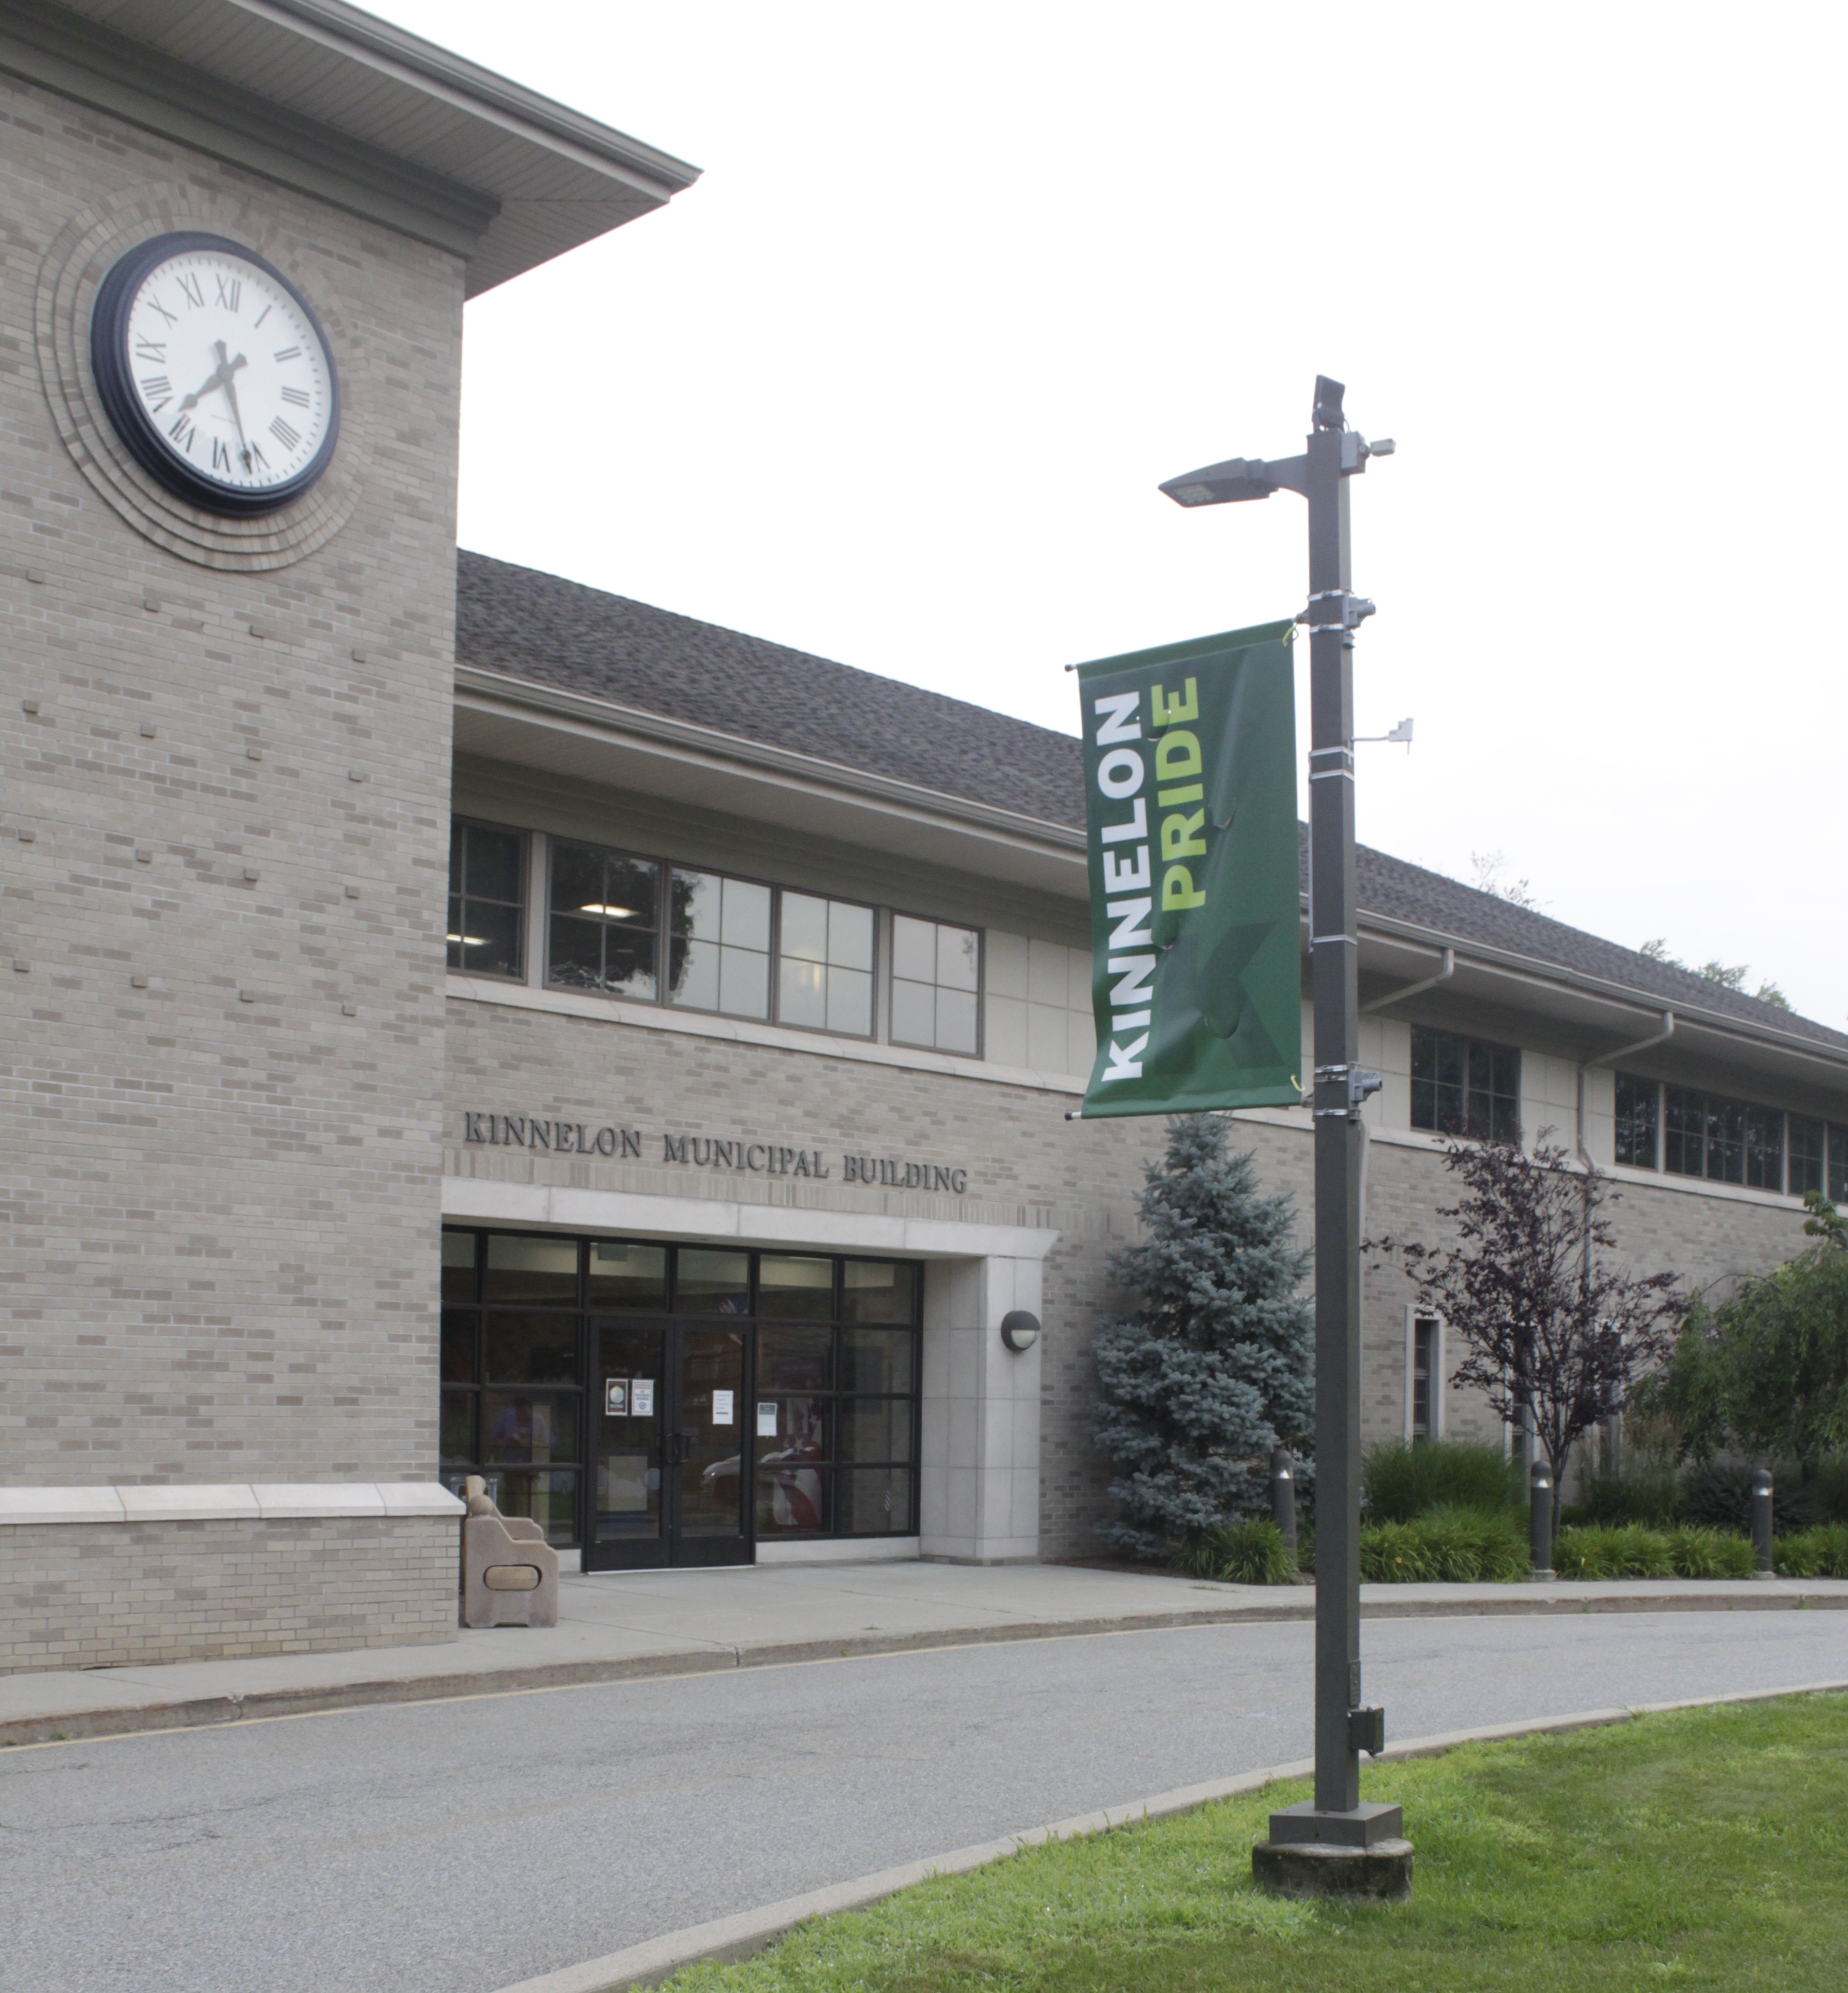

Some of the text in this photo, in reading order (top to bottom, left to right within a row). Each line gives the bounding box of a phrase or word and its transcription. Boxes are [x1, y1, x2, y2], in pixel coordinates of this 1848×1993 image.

[176, 271, 205, 310] XI
[215, 272, 242, 313] XII
[147, 293, 178, 330] X
[135, 331, 167, 363] IX
[273, 345, 302, 363] II
[281, 386, 310, 409] III
[168, 413, 196, 454] VII
[212, 435, 231, 473] VI
[1151, 676, 1206, 912] PRIDE
[1096, 691, 1156, 1082] KINNELON
[465, 1111, 968, 1194] KINNELON MUNICIPAL BUILDING
